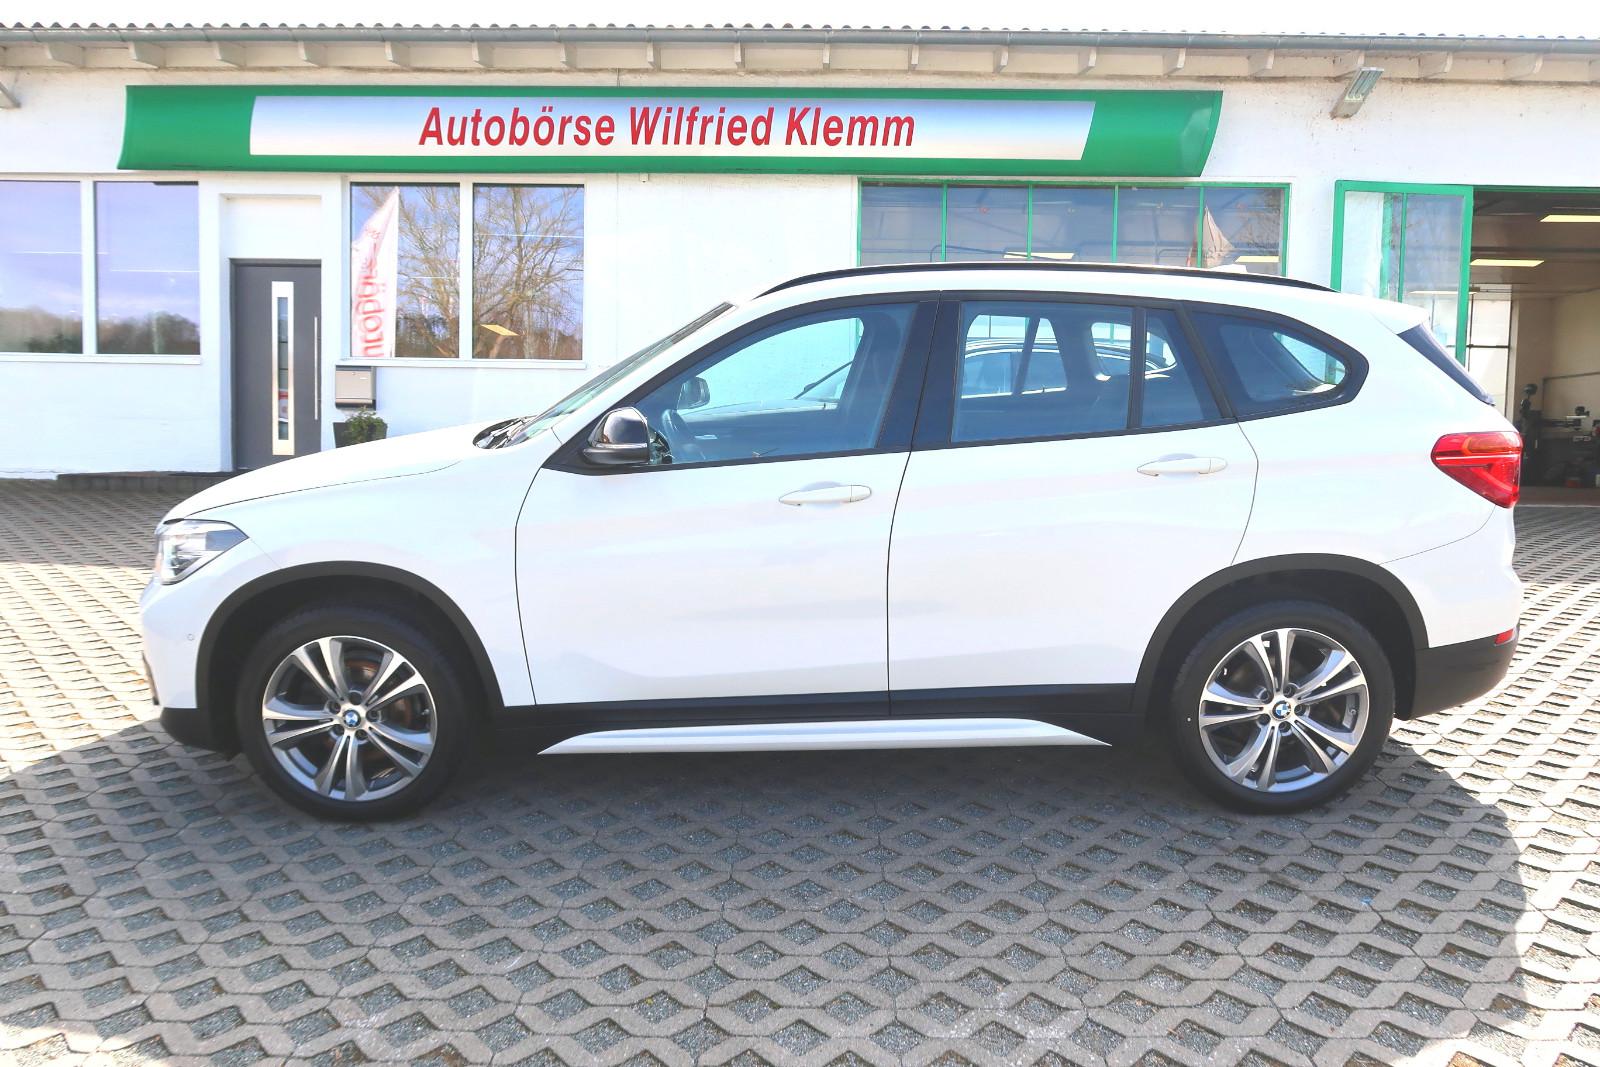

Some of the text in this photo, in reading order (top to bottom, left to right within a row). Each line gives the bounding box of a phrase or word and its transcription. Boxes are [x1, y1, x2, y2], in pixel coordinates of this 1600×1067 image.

[419, 106, 915, 147] Autobörse Wilfried Klemm
